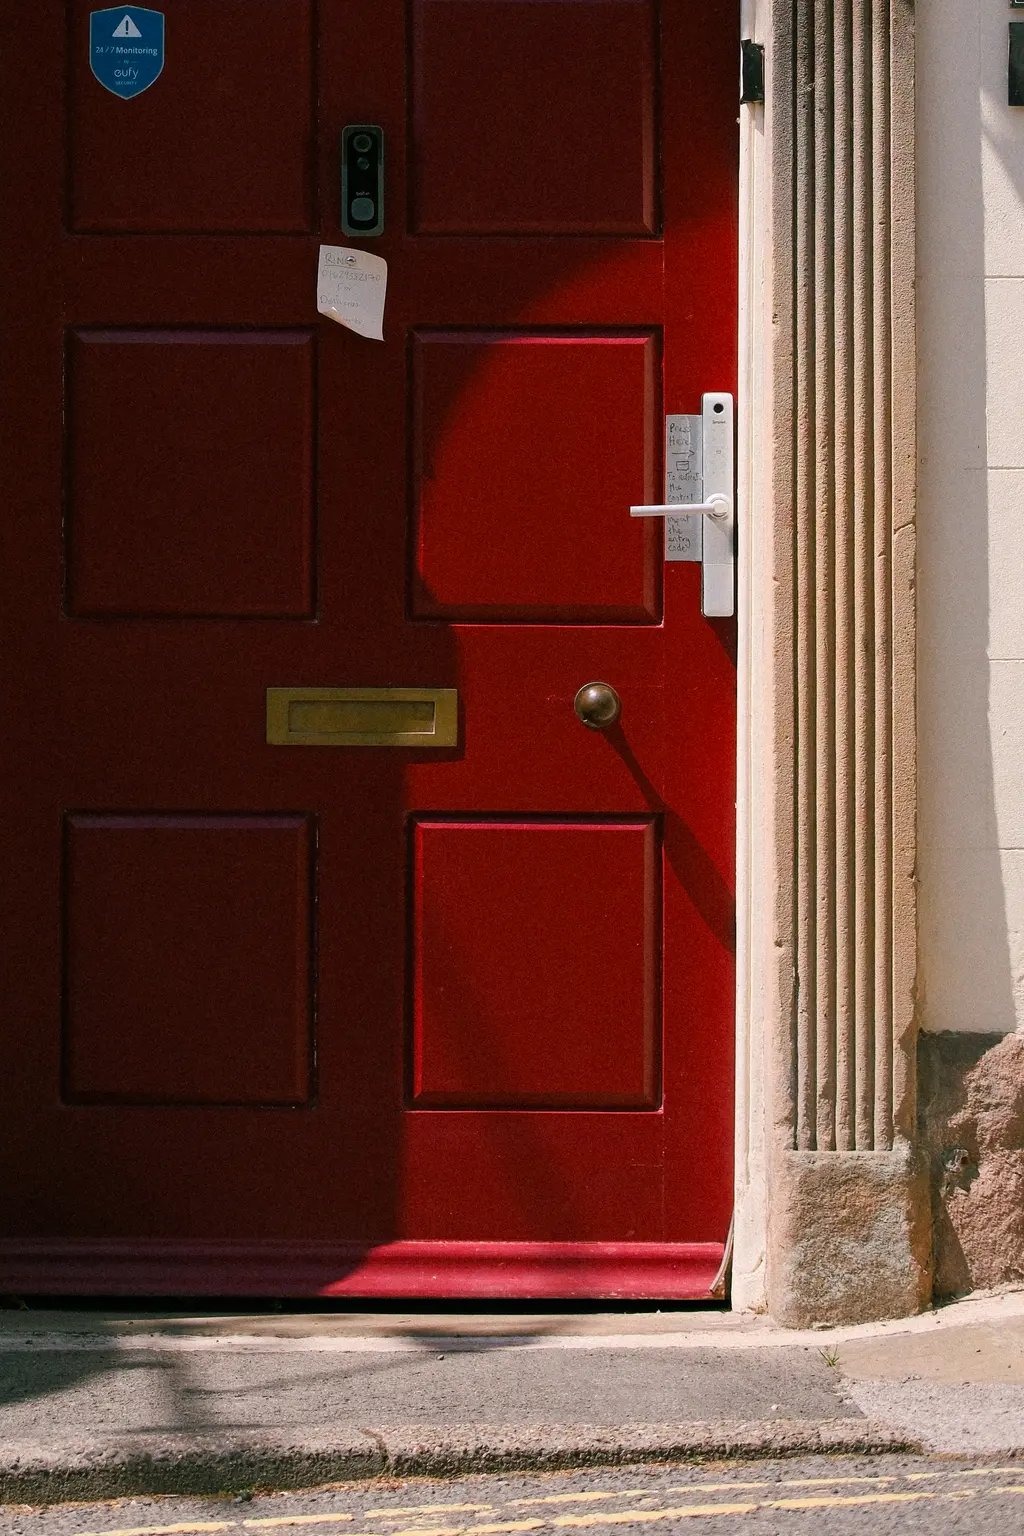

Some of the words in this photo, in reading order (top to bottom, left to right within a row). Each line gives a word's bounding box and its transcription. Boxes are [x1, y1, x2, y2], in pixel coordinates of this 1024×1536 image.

[116, 46, 158, 57] Monitoring
[114, 67, 139, 80] eufy
[325, 252, 356, 265] RIN
